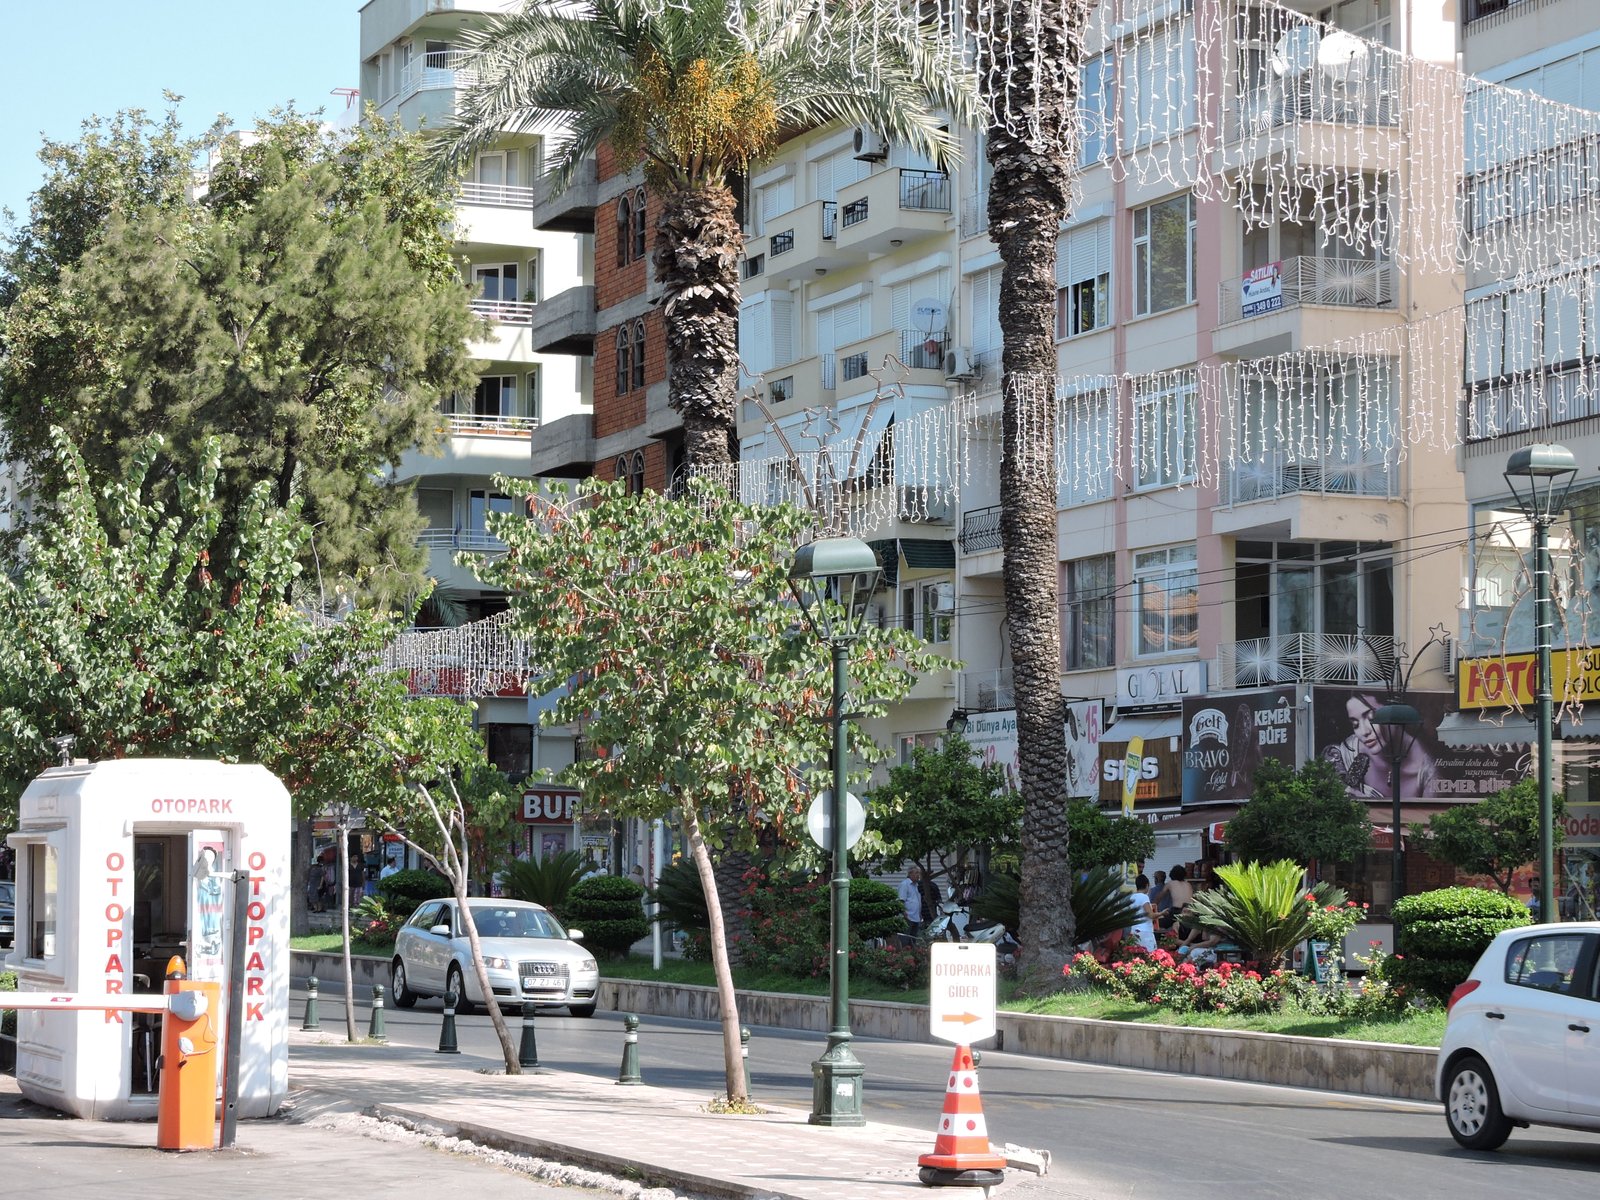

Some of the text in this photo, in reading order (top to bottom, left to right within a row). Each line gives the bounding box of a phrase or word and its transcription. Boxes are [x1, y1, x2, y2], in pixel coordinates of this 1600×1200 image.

[976, 718, 1000, 735] Dünya
[1085, 705, 1099, 744] 15
[1196, 714, 1223, 732] Golf
[1254, 707, 1292, 727] KEMER
[1258, 725, 1288, 746] BÜFE
[1103, 756, 1159, 782] SS
[1184, 748, 1230, 772] BRAVO
[1432, 779, 1477, 793] KEMER
[151, 798, 233, 814] OTOPARK
[1559, 812, 1600, 836] Koda
[105, 852, 124, 1024] OTOPARK
[246, 851, 266, 1021] OTOPARK
[935, 963, 991, 977] OTOPARKA
